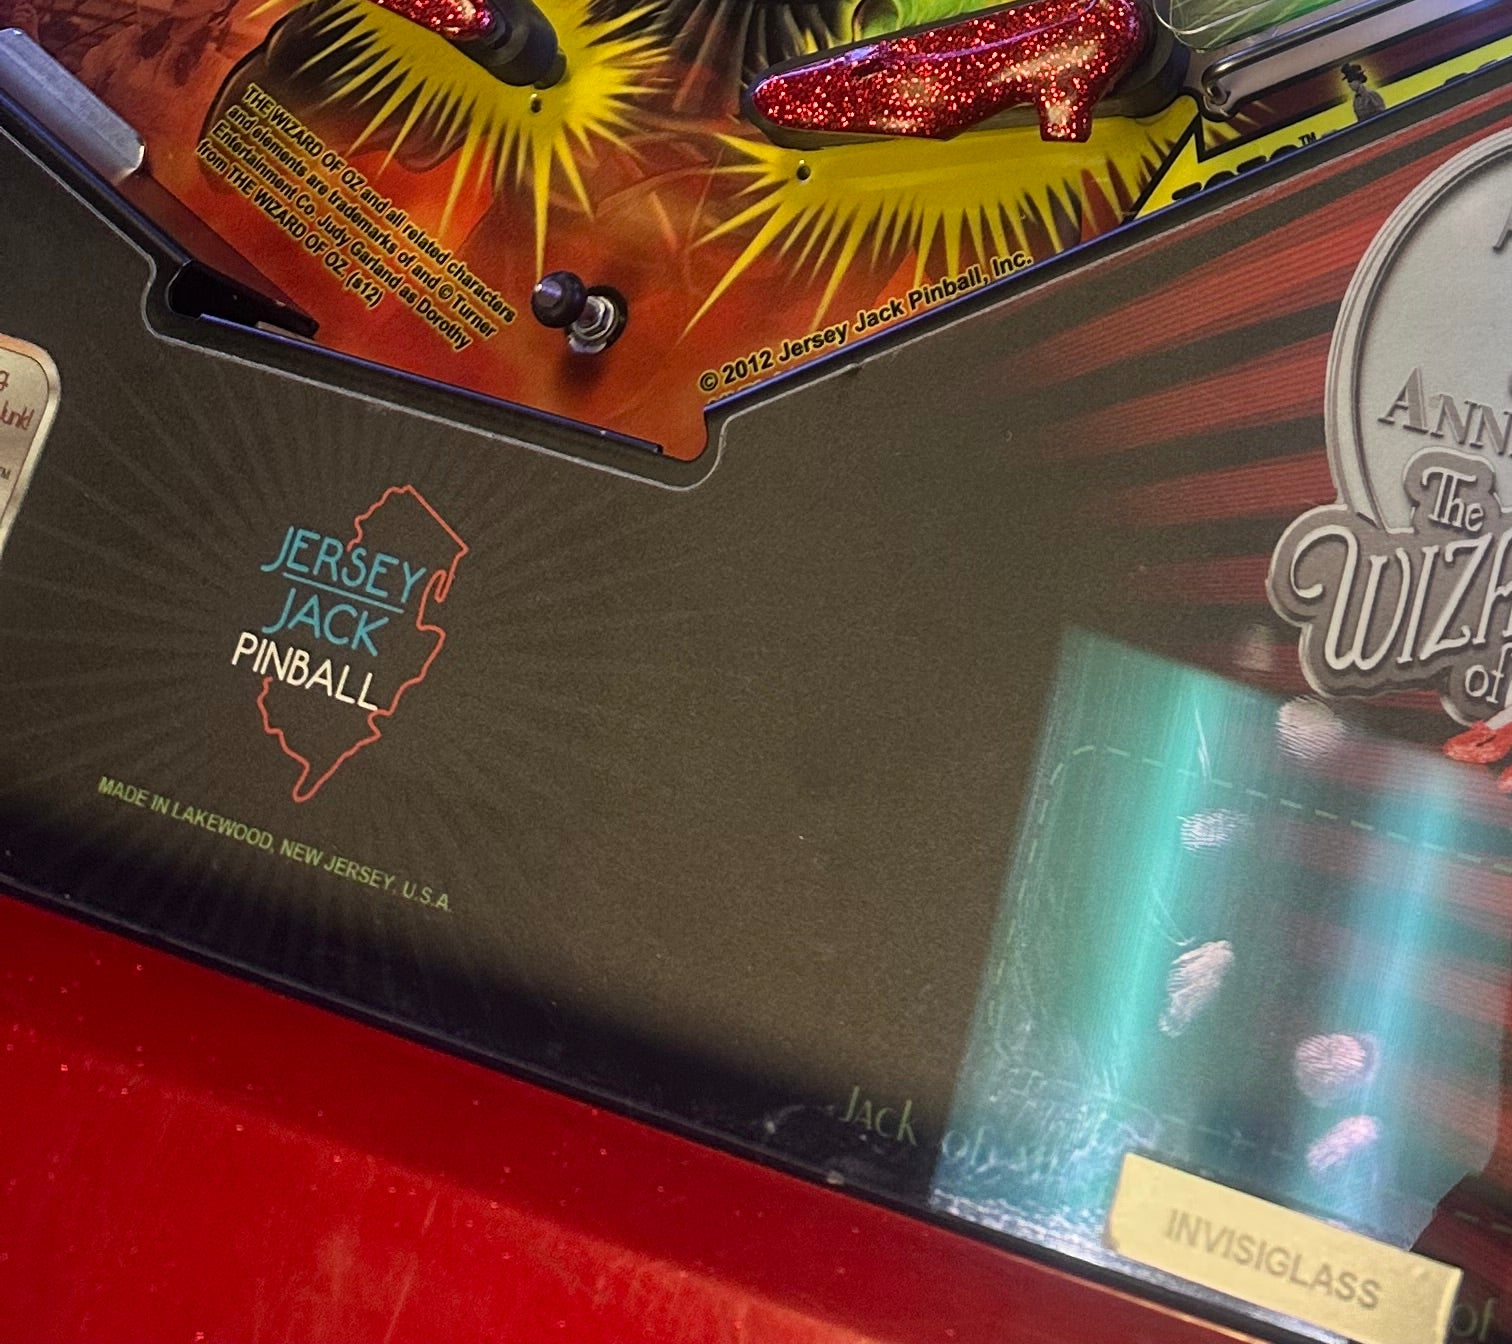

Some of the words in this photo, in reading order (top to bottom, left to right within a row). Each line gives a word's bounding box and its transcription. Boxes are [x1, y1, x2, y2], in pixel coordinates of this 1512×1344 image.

[196, 142, 231, 173] from
[226, 165, 256, 197] THE
[253, 189, 307, 241] WIZARD
[304, 231, 329, 257] OF
[211, 122, 298, 202] Entertainment
[295, 196, 319, 220] Co.
[316, 214, 352, 249] Judy
[349, 240, 403, 291] Garland
[398, 282, 417, 305] as
[415, 301, 473, 352] Dorothy
[227, 105, 256, 131] and
[249, 123, 309, 179] elements
[305, 173, 329, 197] are
[327, 188, 398, 256] trademarks
[396, 249, 416, 270] of
[411, 263, 440, 291] and
[450, 293, 497, 340] Turner
[244, 85, 274, 117] THE
[271, 106, 324, 160] WIZARD
[321, 148, 346, 173] OF
[341, 165, 368, 192] OZ
[360, 186, 388, 213] and
[385, 205, 405, 229] all
[402, 215, 450, 267] related
[446, 257, 517, 324] characters
[722, 350, 775, 386] 2012
[778, 323, 849, 364] Jersey
[855, 299, 905, 334] Jack
[908, 267, 991, 311] Pinball,
[992, 250, 1034, 279] Inc.
[1422, 462, 1486, 534] The
[261, 527, 427, 607] JERSEY
[262, 588, 390, 657] JACK
[231, 632, 381, 712] PINBALL
[99, 776, 150, 809] MADE
[151, 795, 172, 814] IN
[172, 802, 276, 854] LAKEWOOD,
[280, 839, 325, 866] NEW
[324, 855, 397, 894] JERSEY,
[402, 883, 452, 912] U.S.A.
[1165, 1206, 1384, 1312] INVISIGLASS
